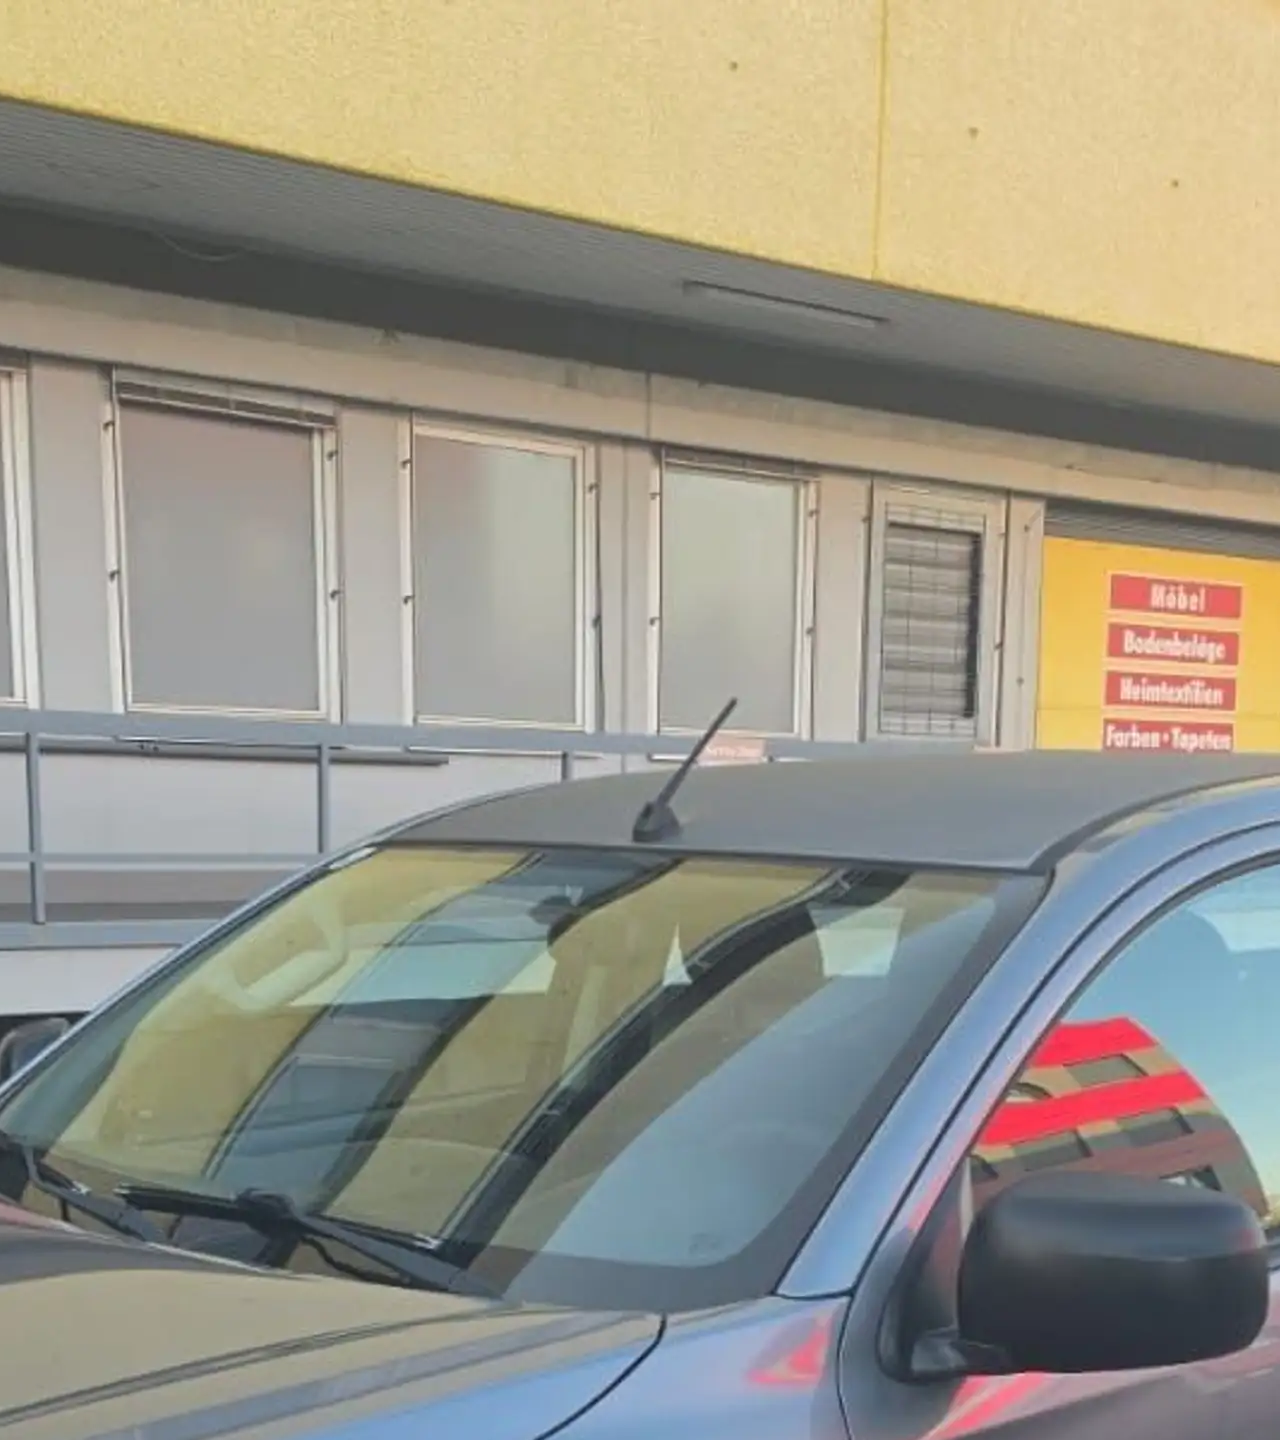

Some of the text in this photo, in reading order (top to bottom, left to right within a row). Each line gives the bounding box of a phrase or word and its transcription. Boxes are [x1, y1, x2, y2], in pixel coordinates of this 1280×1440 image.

[1151, 584, 1206, 612] Möbel
[1106, 723, 1231, 752] Farben Tapeten
